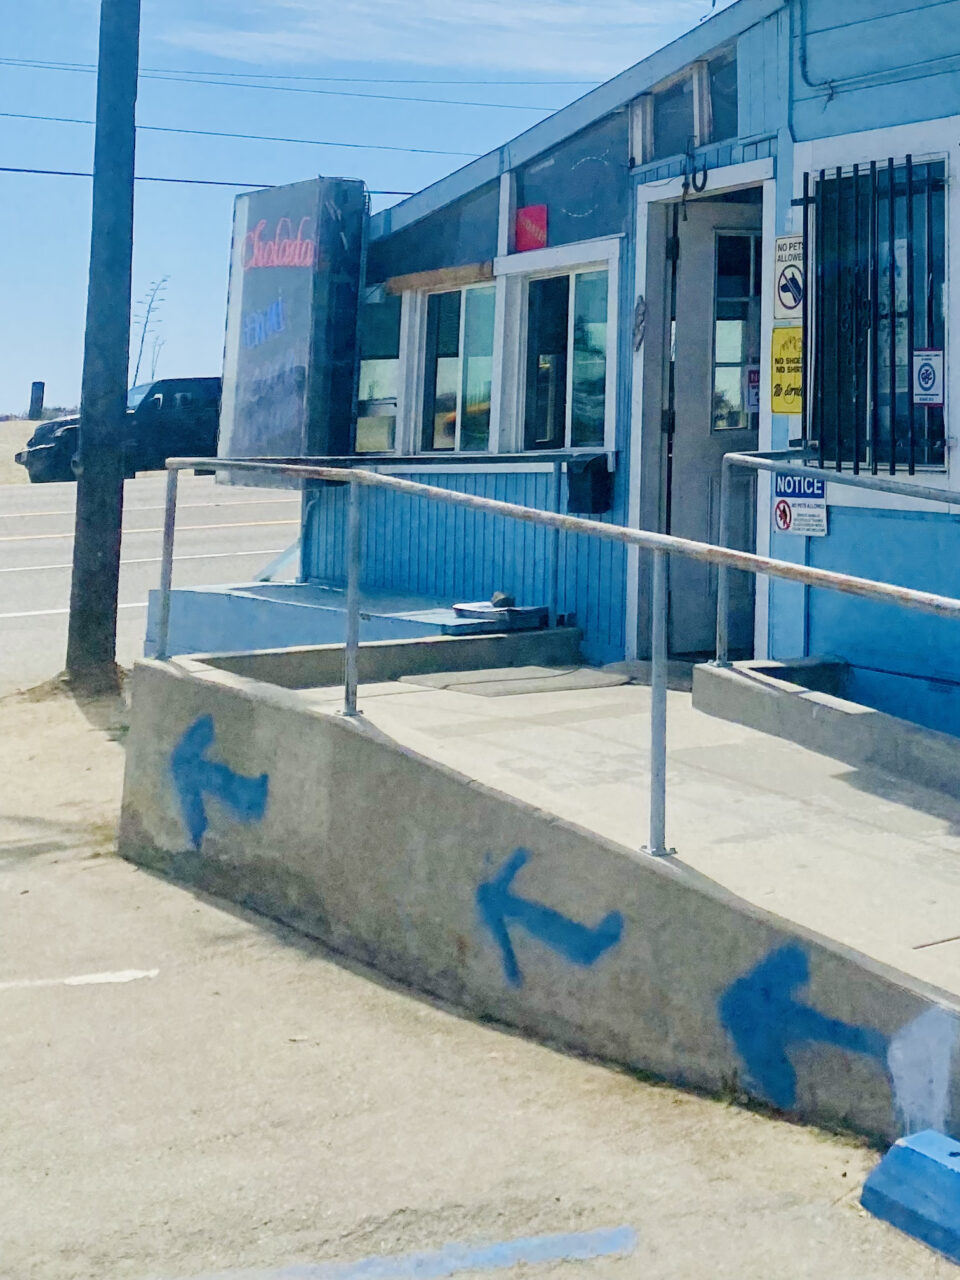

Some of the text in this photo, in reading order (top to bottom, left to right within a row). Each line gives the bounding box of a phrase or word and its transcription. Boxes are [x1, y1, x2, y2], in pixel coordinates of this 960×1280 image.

[777, 243, 787, 252] NO
[777, 253, 802, 262] ALLOWE
[774, 357, 802, 365] NO SHOE
[775, 366, 786, 374] NO
[776, 476, 822, 494] NOTICE
